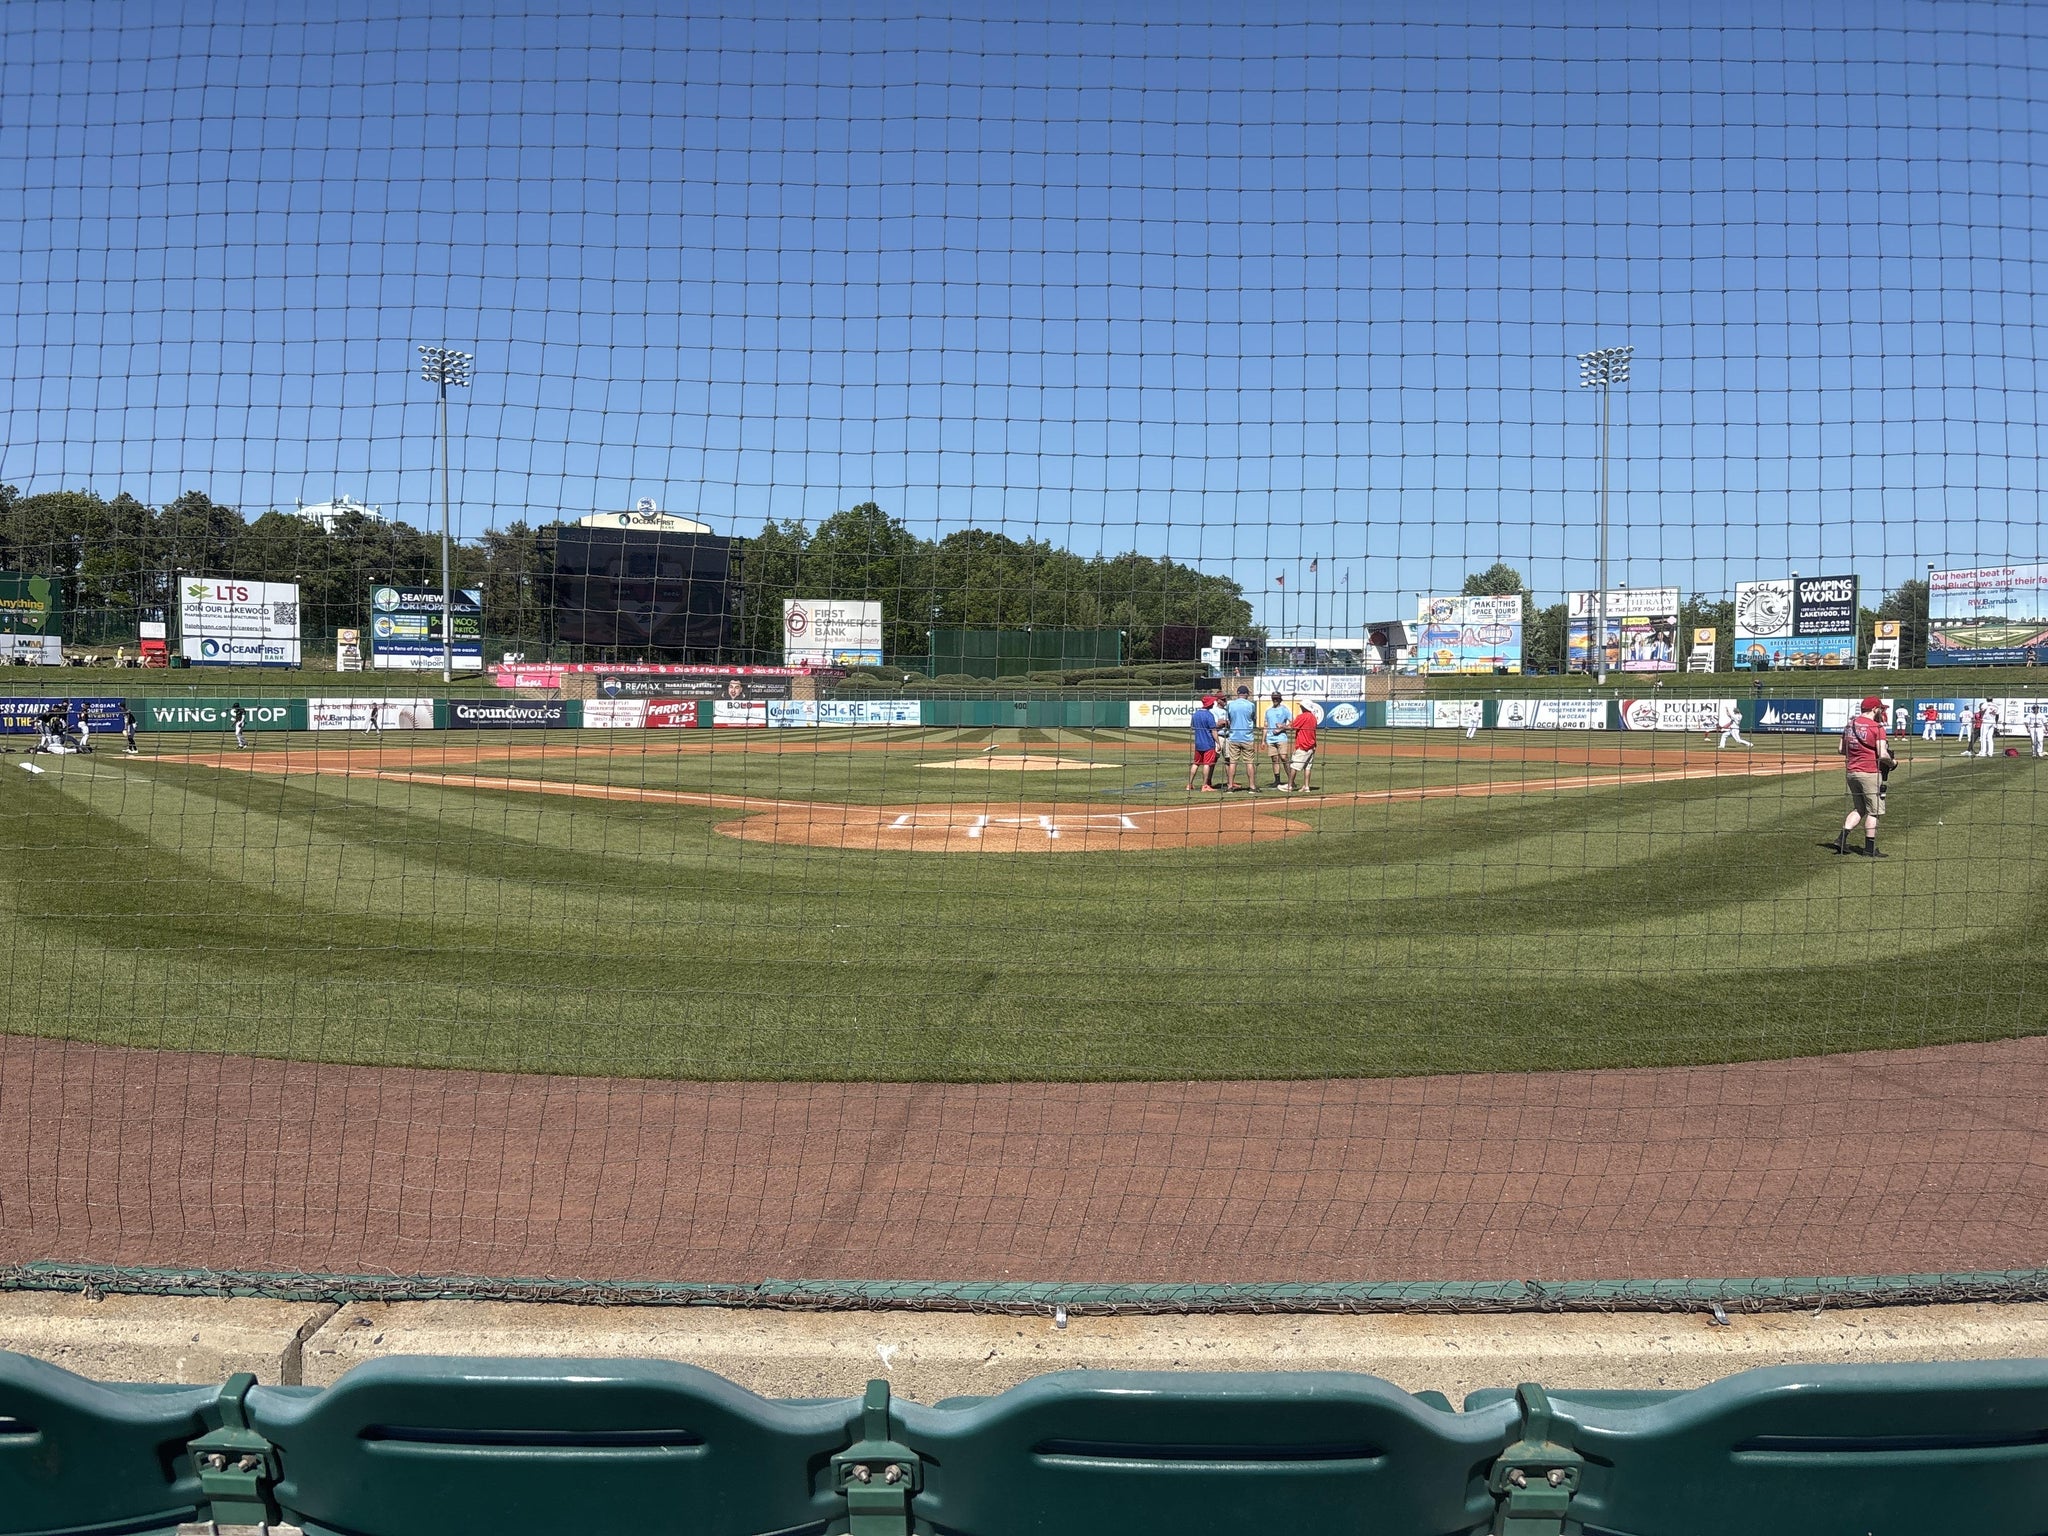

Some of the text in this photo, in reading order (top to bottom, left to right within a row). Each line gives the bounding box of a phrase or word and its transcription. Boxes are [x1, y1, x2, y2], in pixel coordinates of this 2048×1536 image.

[1950, 571, 1976, 579] hearts
[1980, 569, 2000, 578] beat
[1800, 580, 1852, 591] CAMPING
[1948, 580, 1992, 590] BlueClaws
[1995, 578, 2012, 587] and
[2014, 576, 2036, 584] their
[216, 586, 248, 601] LTS
[402, 594, 444, 602] SEAVIEW
[1800, 590, 1852, 603] WORLD
[0, 598, 44, 611] Anything
[1625, 598, 1673, 606] THERAPY
[1738, 583, 1788, 618] WHITE CLAW
[1968, 598, 2018, 606] RWJBarnabas
[224, 606, 270, 615] LAKEWOOD
[402, 602, 471, 612] ORTHOPADICS
[814, 610, 845, 618] FIRST
[1768, 605, 1788, 632] SELTZER
[814, 618, 878, 628] COMMERCE
[814, 628, 846, 636] BANK
[222, 643, 286, 655] OCEANFIRST
[626, 682, 660, 690] RE/MAX
[16, 704, 50, 714] STARTS
[457, 704, 562, 718] Groundworks
[648, 701, 696, 716] FARRO'S
[727, 702, 752, 710] BOLD
[1664, 703, 1718, 713] PUGLISI
[153, 708, 217, 722] WING
[770, 706, 800, 717] Corona
[3, 716, 14, 727] TO
[16, 716, 32, 727] THE
